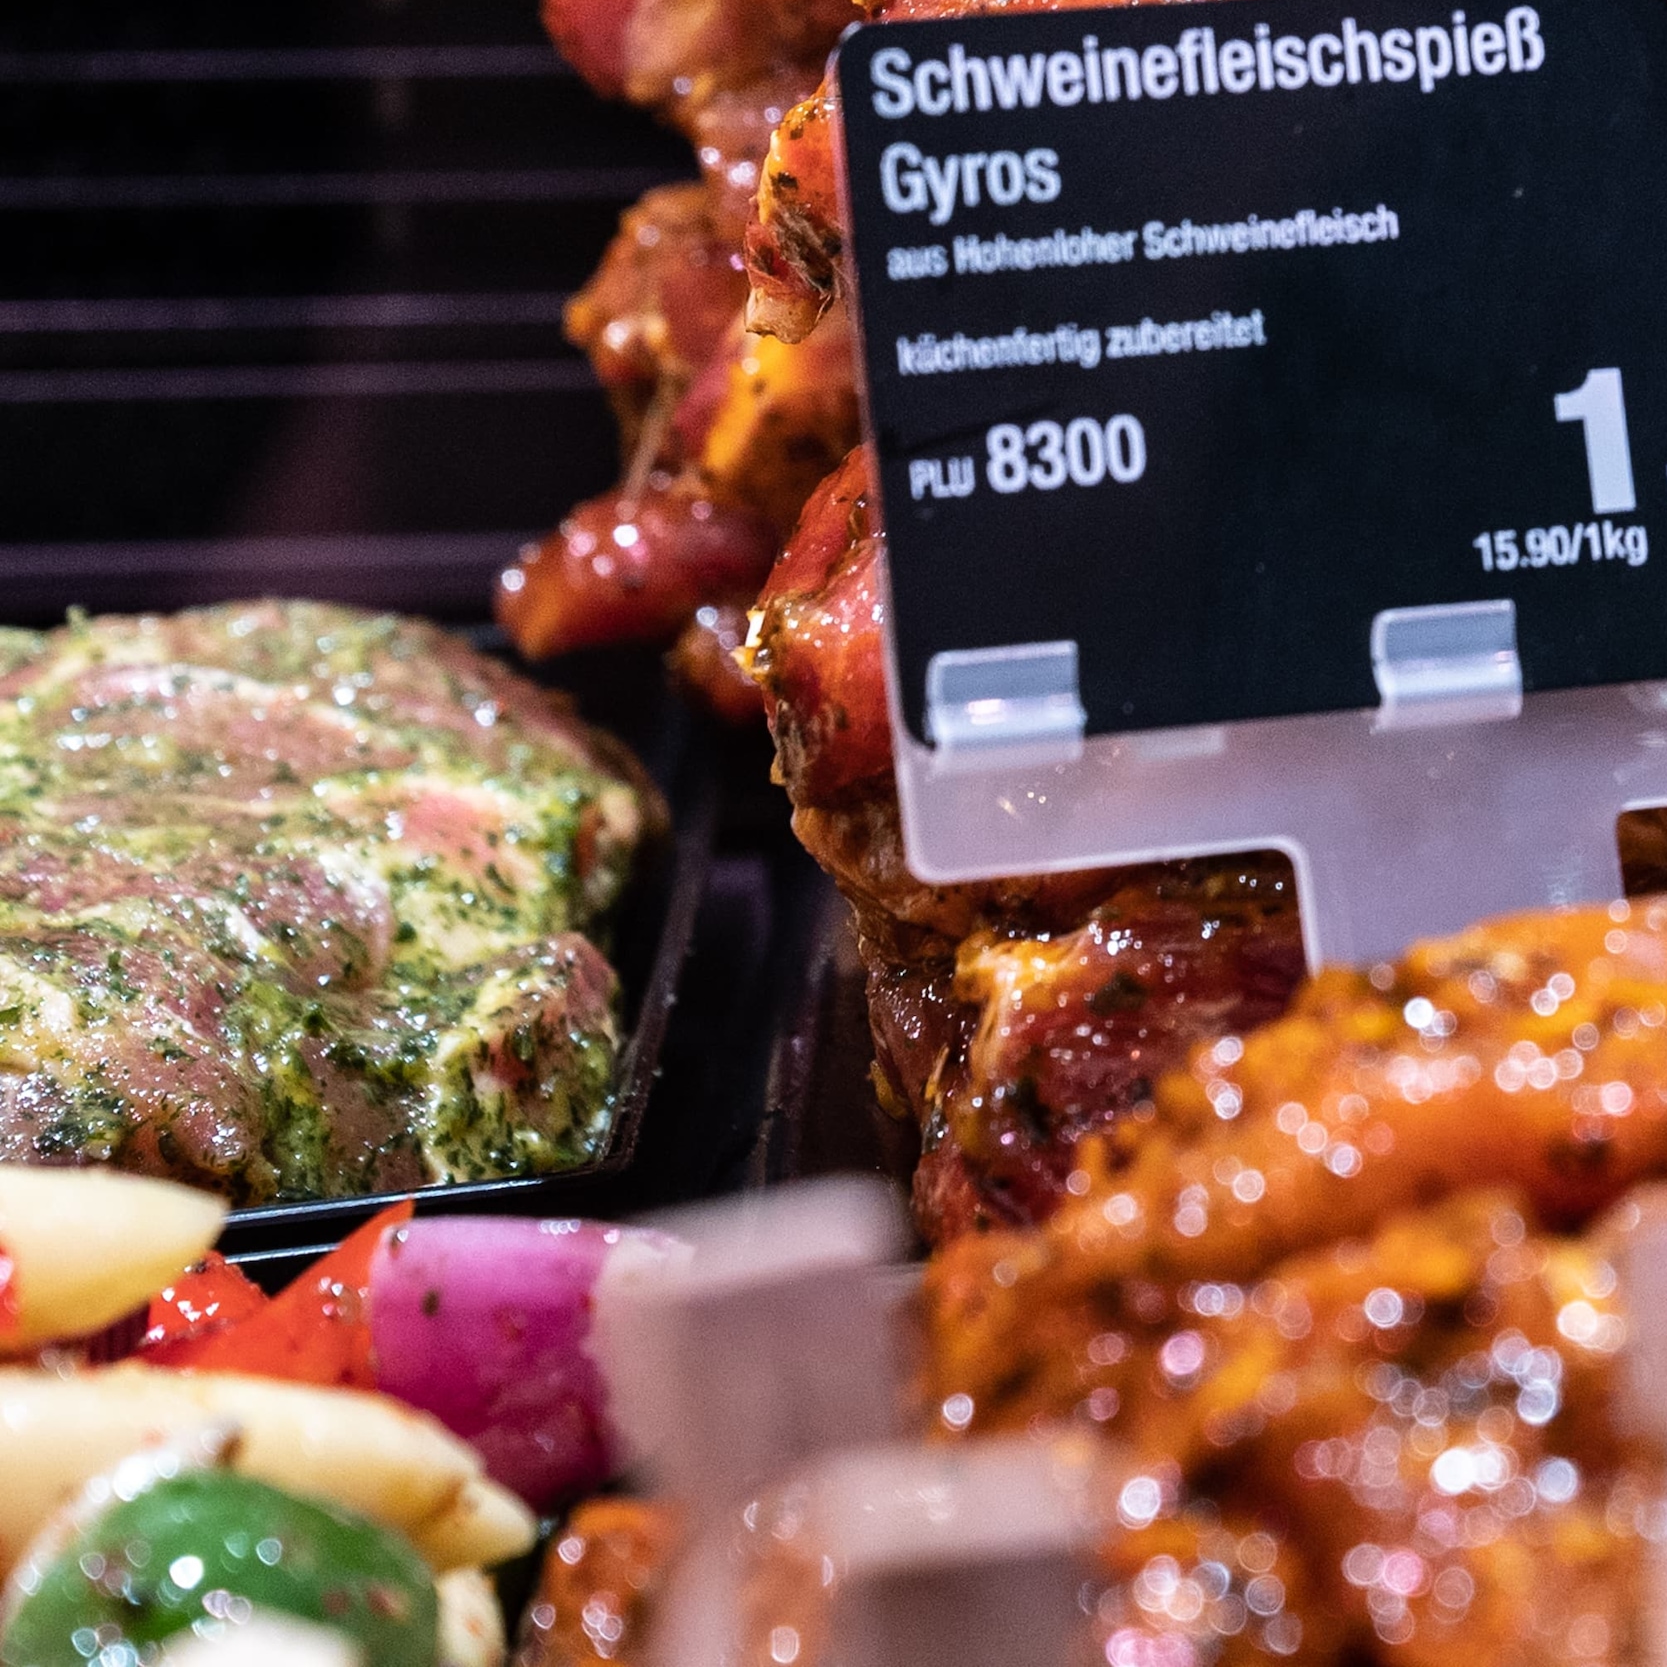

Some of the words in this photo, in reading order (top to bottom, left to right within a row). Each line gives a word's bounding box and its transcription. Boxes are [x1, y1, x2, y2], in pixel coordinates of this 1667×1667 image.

[871, 5, 1545, 117] Schweinefleischspieß
[880, 143, 1061, 225] Gyros
[887, 246, 949, 281] aus
[1142, 203, 1401, 262] Schweinefleisch
[896, 325, 1102, 375] küchenfertig
[1105, 308, 1267, 359] zubereitet
[909, 457, 975, 498] PLU
[986, 414, 1146, 493] 8300
[1473, 520, 1649, 572] 15.90/1kg
